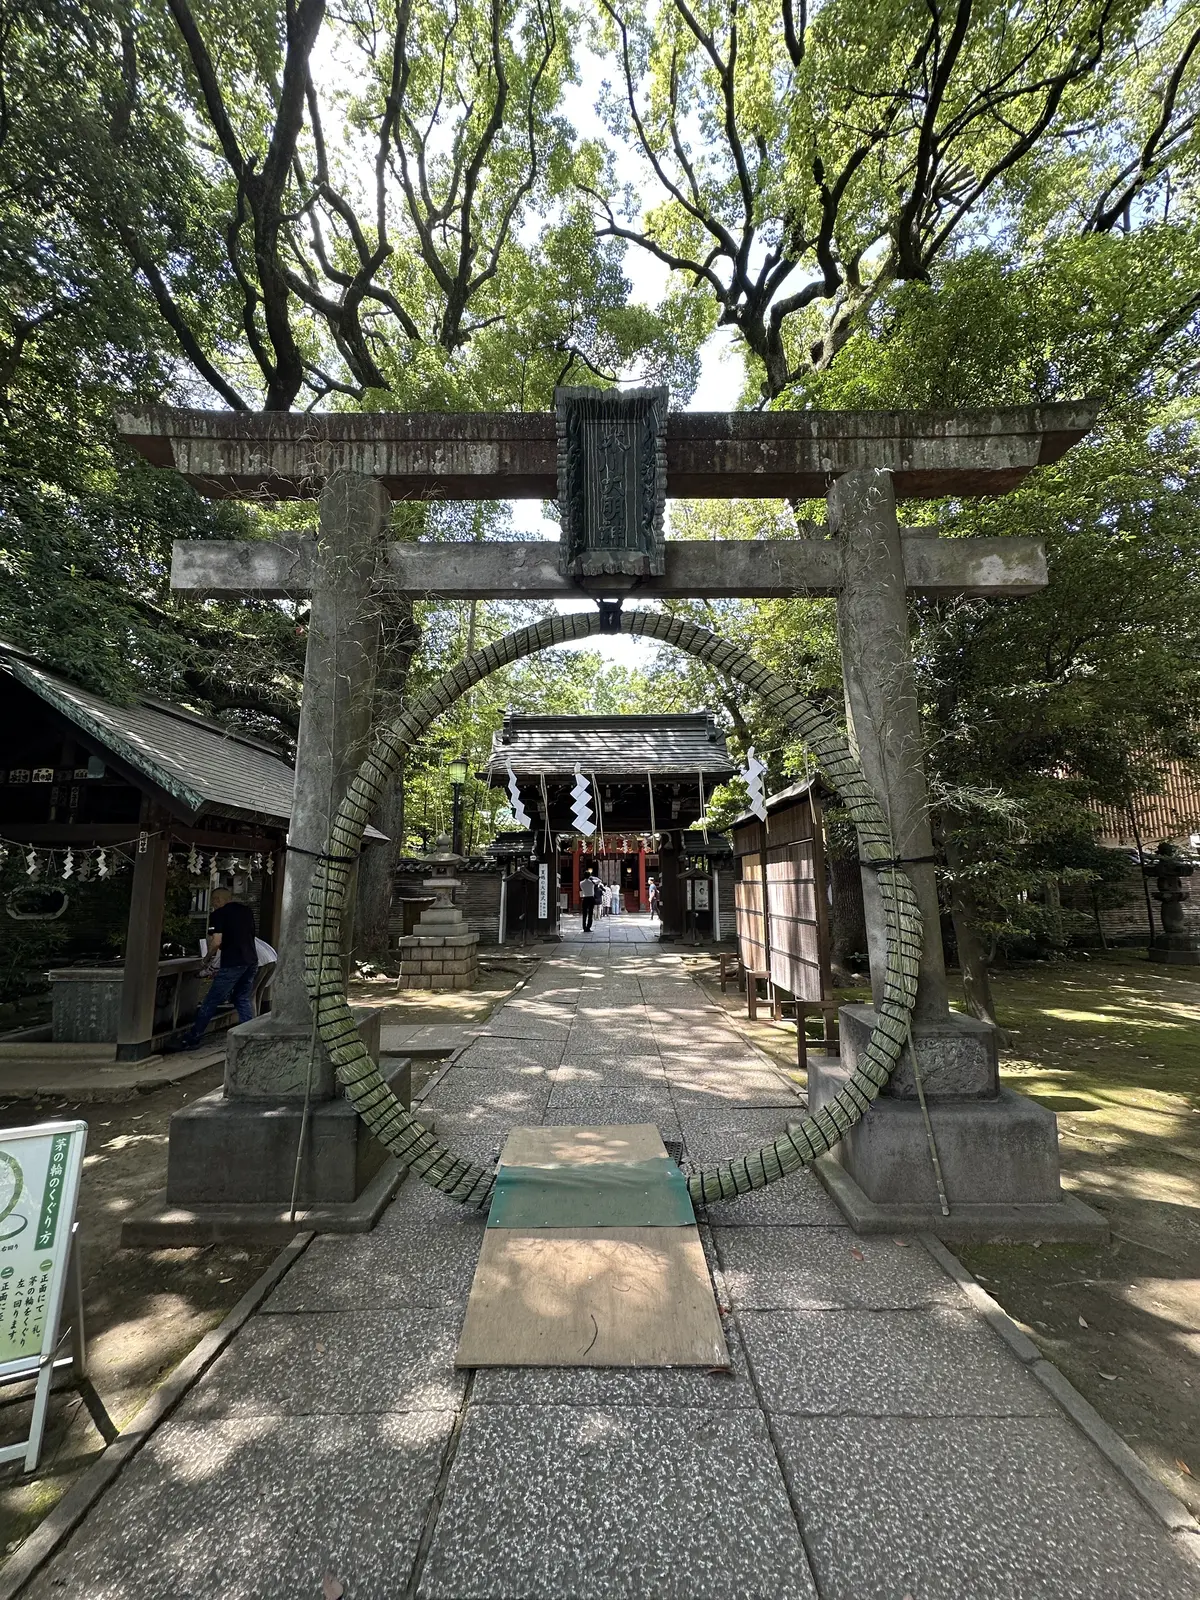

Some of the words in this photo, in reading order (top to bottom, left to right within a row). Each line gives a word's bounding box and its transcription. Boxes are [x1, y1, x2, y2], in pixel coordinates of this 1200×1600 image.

[39, 1137, 67, 1246] 茅の輪のくぐり方
[8, 1277, 26, 1344] 左へ回ります。
[19, 1275, 38, 1348] 茅の輪をくぐり
